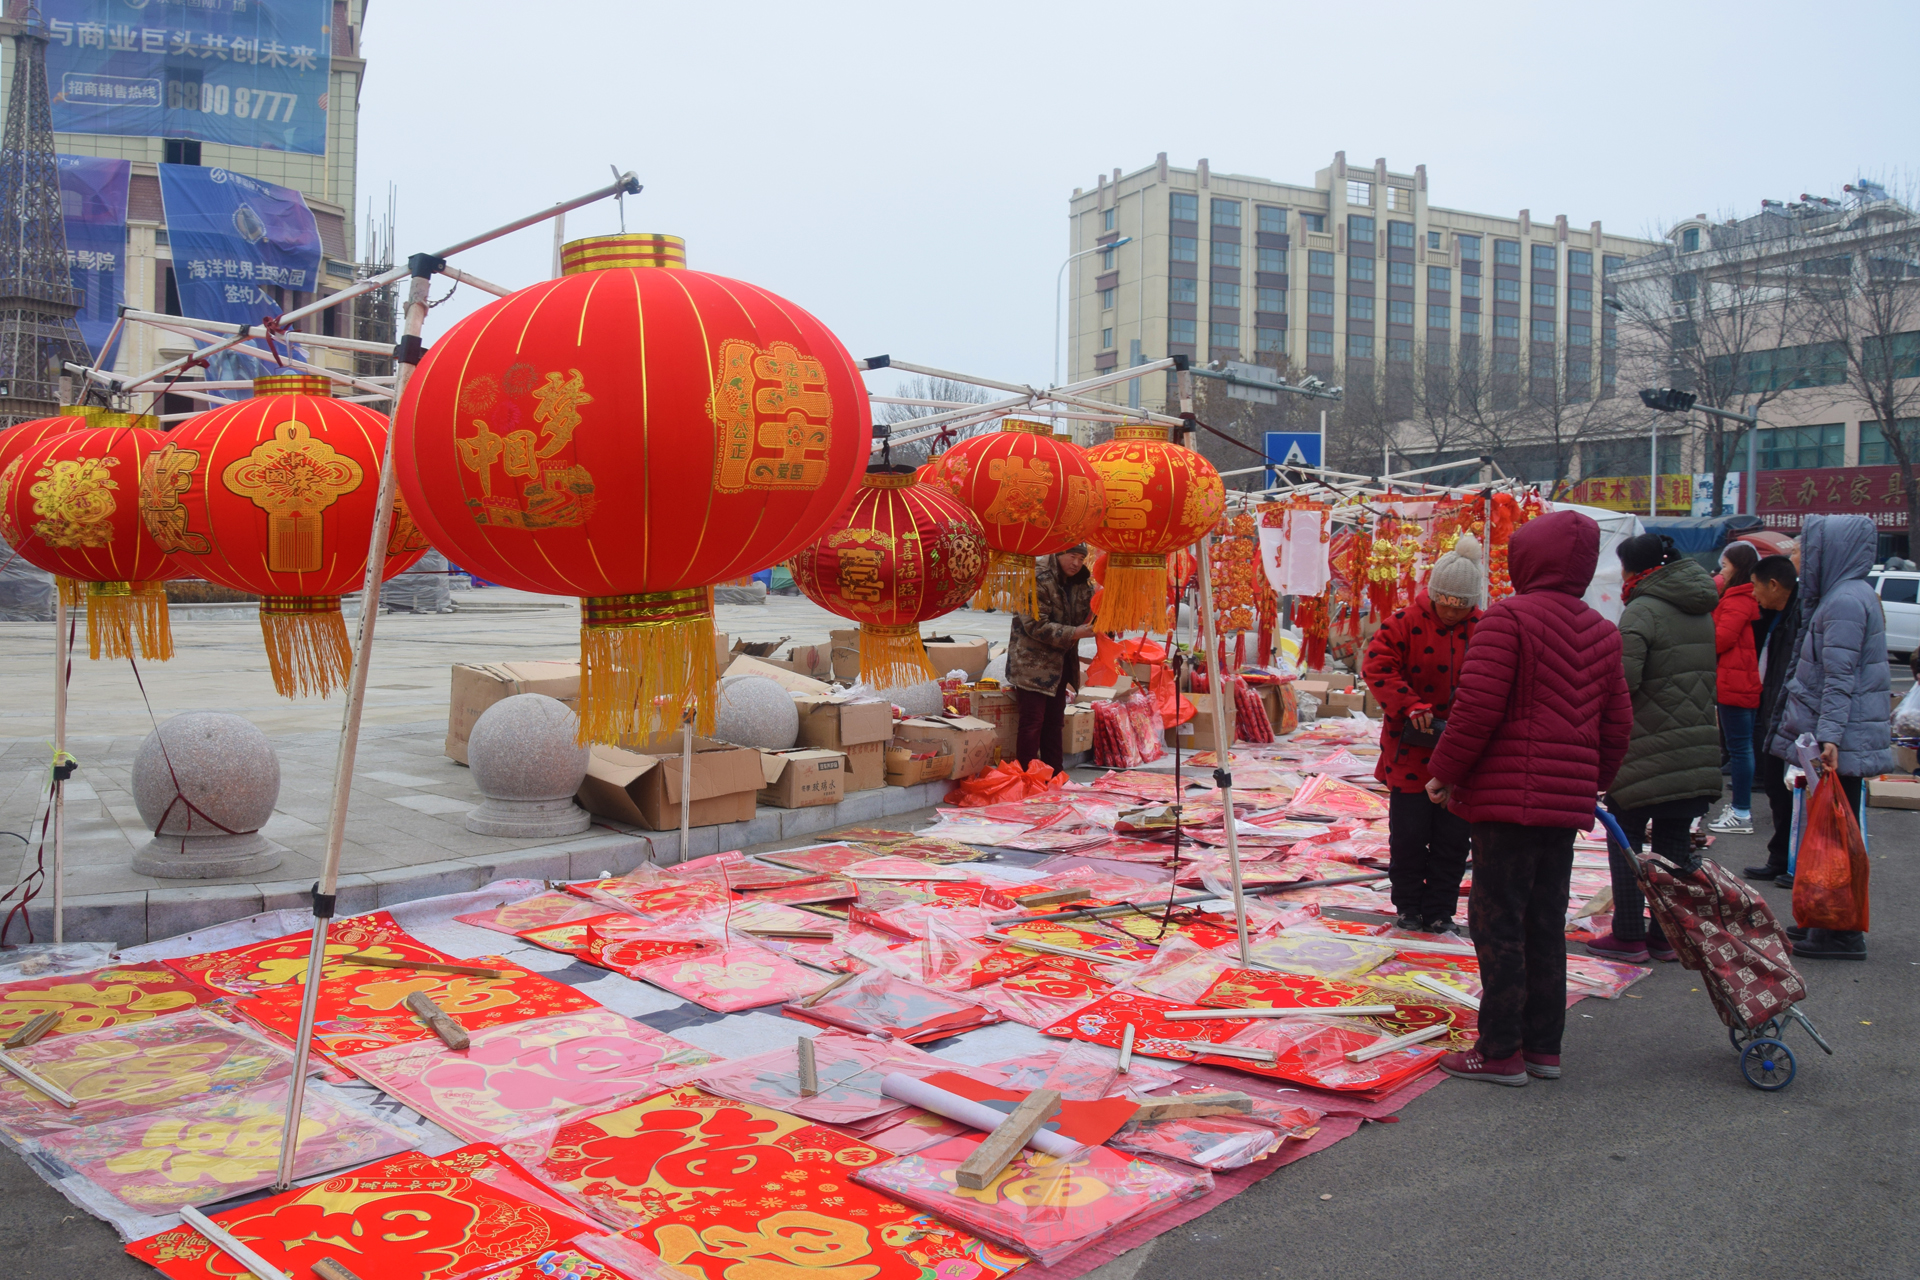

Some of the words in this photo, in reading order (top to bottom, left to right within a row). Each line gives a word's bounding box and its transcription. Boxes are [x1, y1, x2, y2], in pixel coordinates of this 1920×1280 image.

[49, 18, 317, 72] 与商业巨头共创未来
[68, 80, 157, 101] 招商销售热线
[167, 80, 230, 115] 6800
[234, 88, 298, 124] 8777
[187, 260, 306, 287] 海洋世界主题公园
[224, 284, 280, 306] 签约入
[730, 422, 749, 460] 公正
[1671, 478, 1691, 506] 家具
[812, 779, 836, 792] 玻璃水
